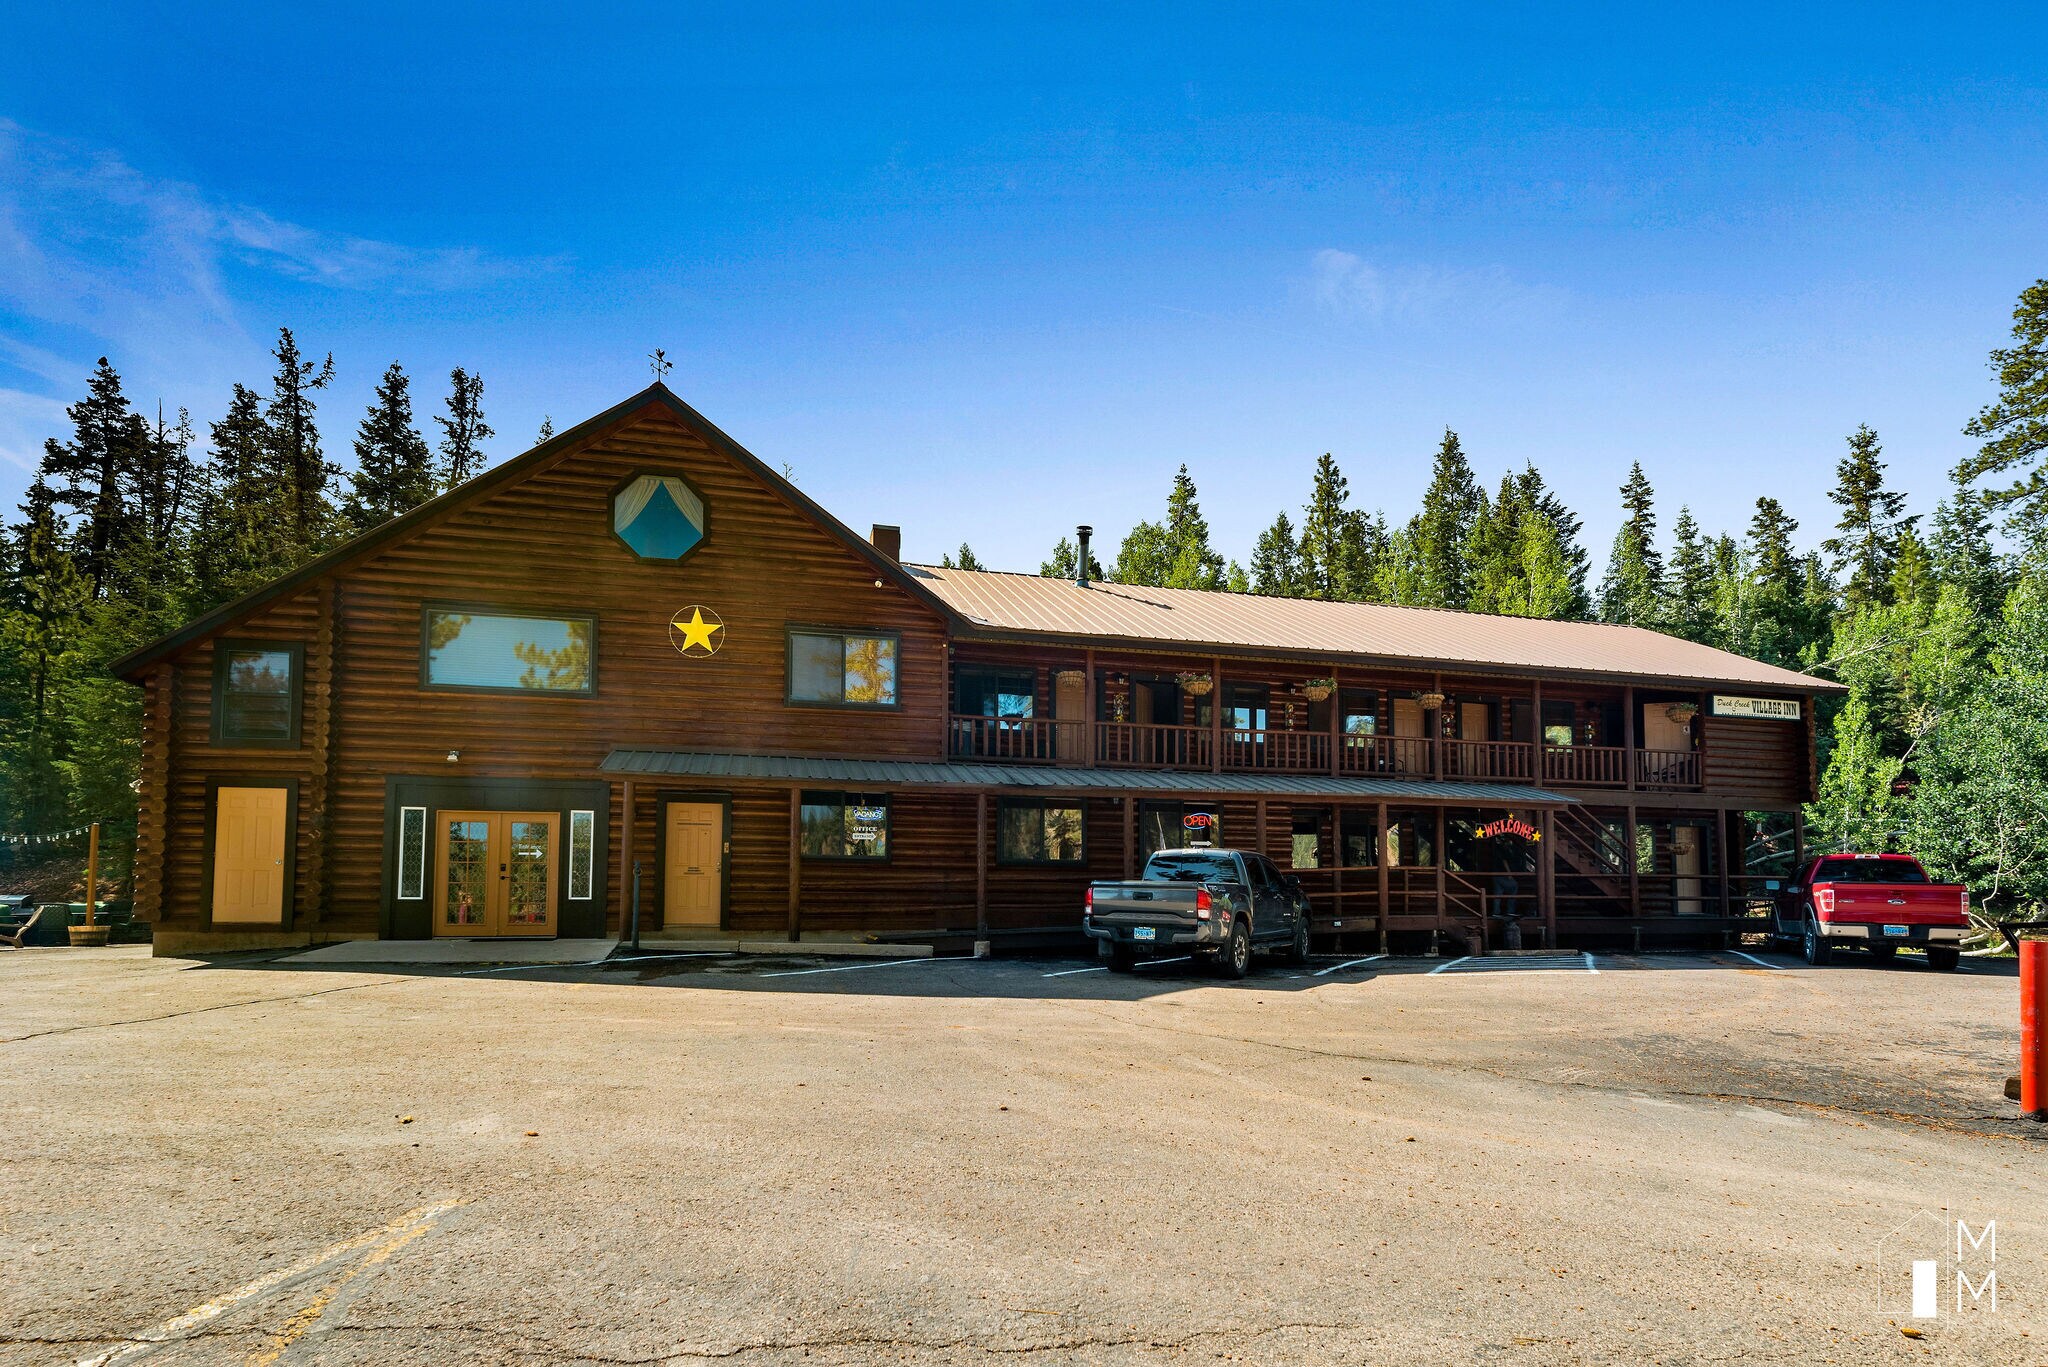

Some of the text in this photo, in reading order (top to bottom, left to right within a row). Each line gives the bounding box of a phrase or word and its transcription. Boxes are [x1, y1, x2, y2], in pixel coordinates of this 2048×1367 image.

[1717, 698, 1732, 707] Duck
[1733, 699, 1750, 708] Creek
[1751, 700, 1782, 715] VILLAGE
[1783, 702, 1797, 716] INN
[1183, 815, 1213, 827] OPEN
[1483, 819, 1535, 840] WELCOME
